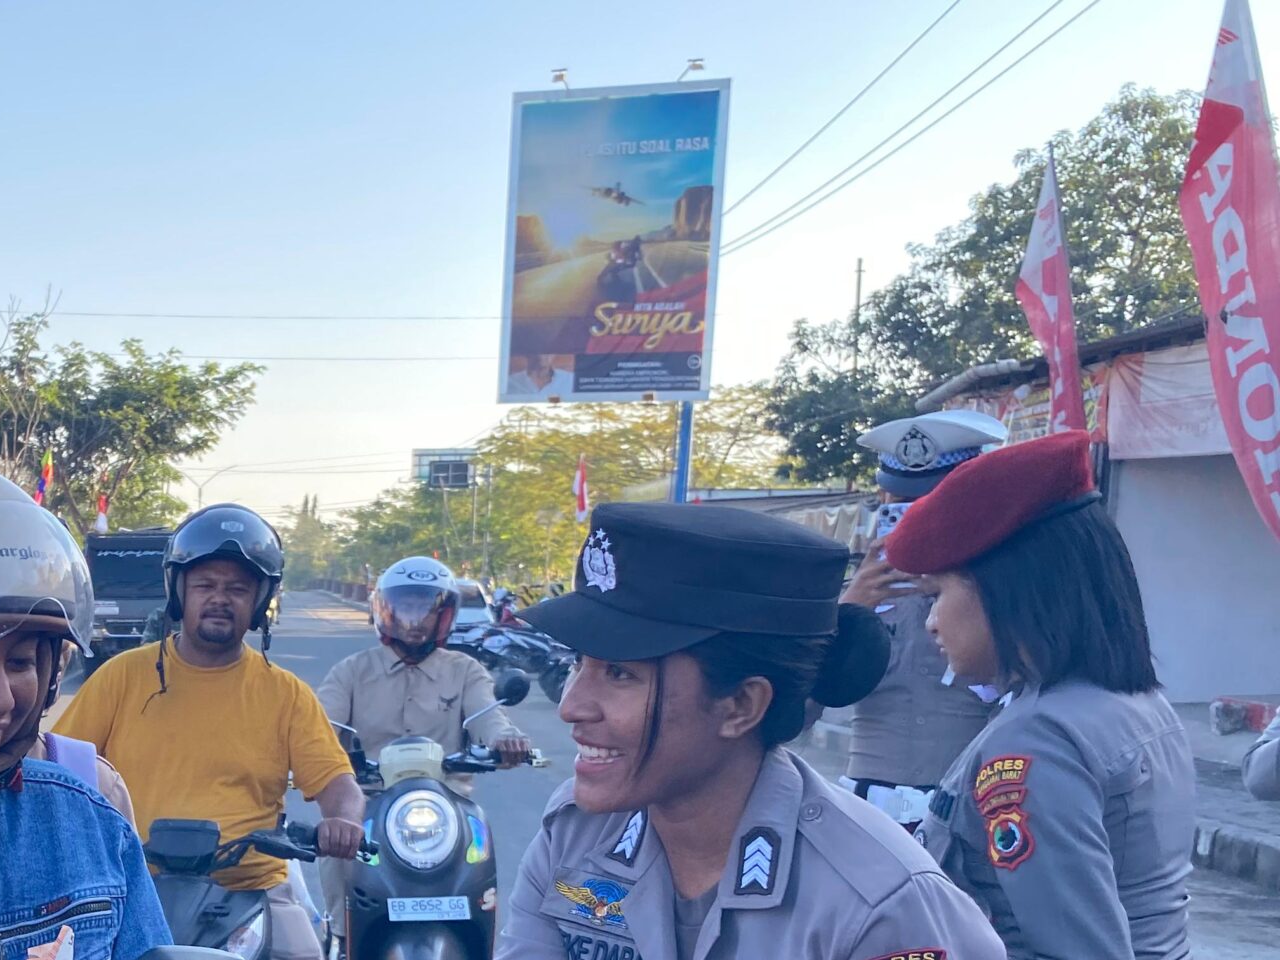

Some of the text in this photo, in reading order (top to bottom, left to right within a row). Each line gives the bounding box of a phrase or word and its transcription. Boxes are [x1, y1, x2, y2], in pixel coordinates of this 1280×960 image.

[616, 141, 636, 155] ITU
[639, 139, 671, 154] SOAL
[675, 136, 710, 151] RASA
[590, 301, 705, 350] Surya
[391, 900, 406, 912] EB
[411, 899, 443, 912] 2652
